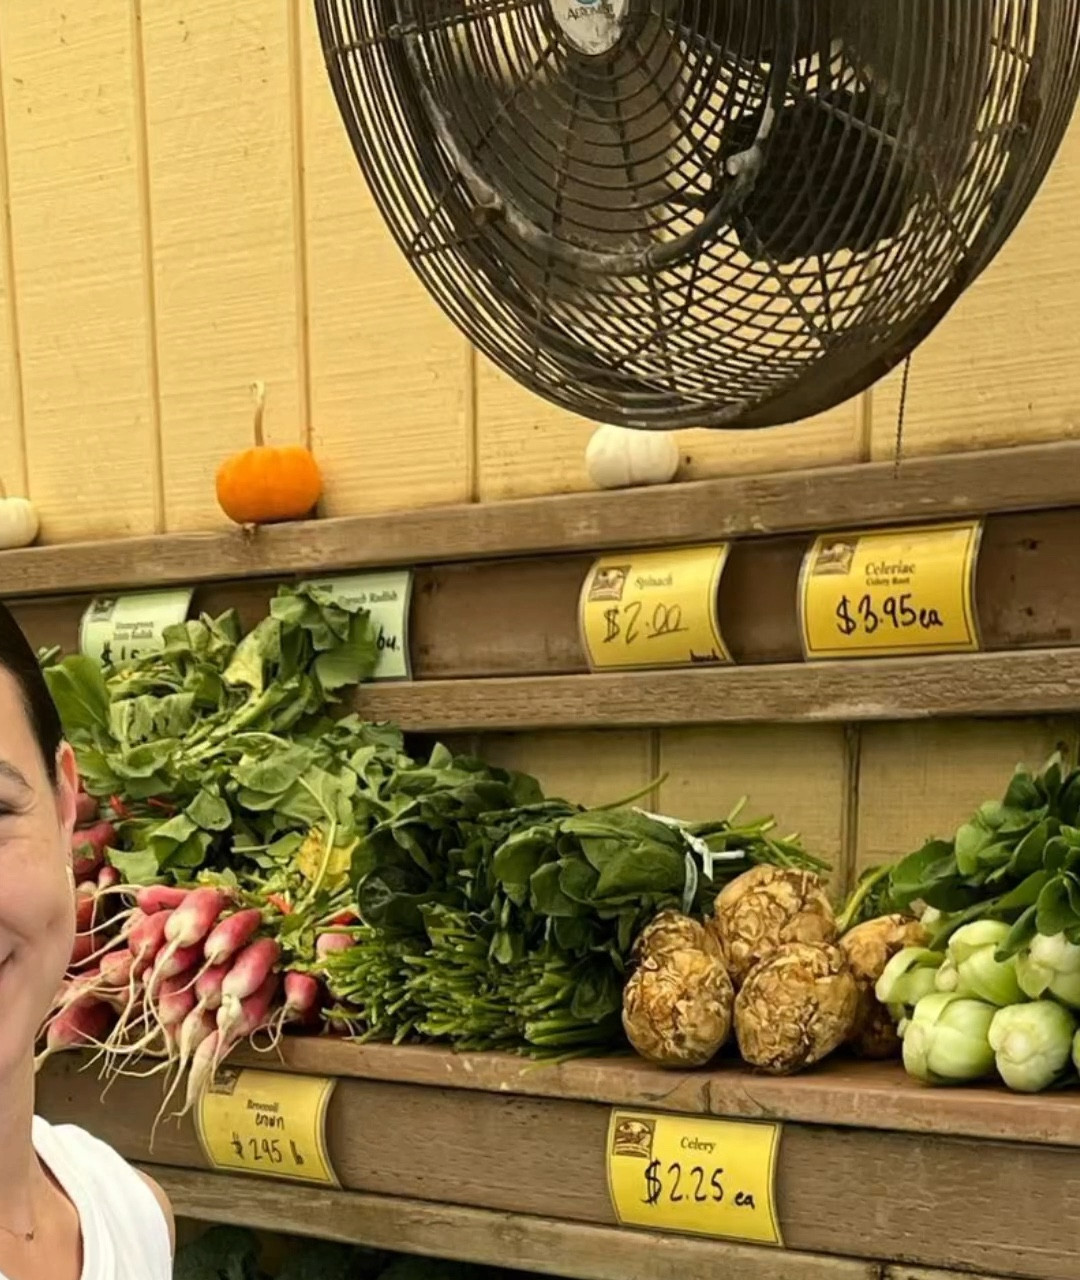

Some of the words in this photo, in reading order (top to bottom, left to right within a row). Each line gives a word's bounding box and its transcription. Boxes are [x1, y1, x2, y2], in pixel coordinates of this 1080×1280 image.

[864, 559, 916, 577] Celeriac
[602, 601, 689, 645] $2.00
[680, 1136, 717, 1154] Celery
[640, 1156, 724, 1206] $2.25
[734, 1190, 756, 1210] ea
